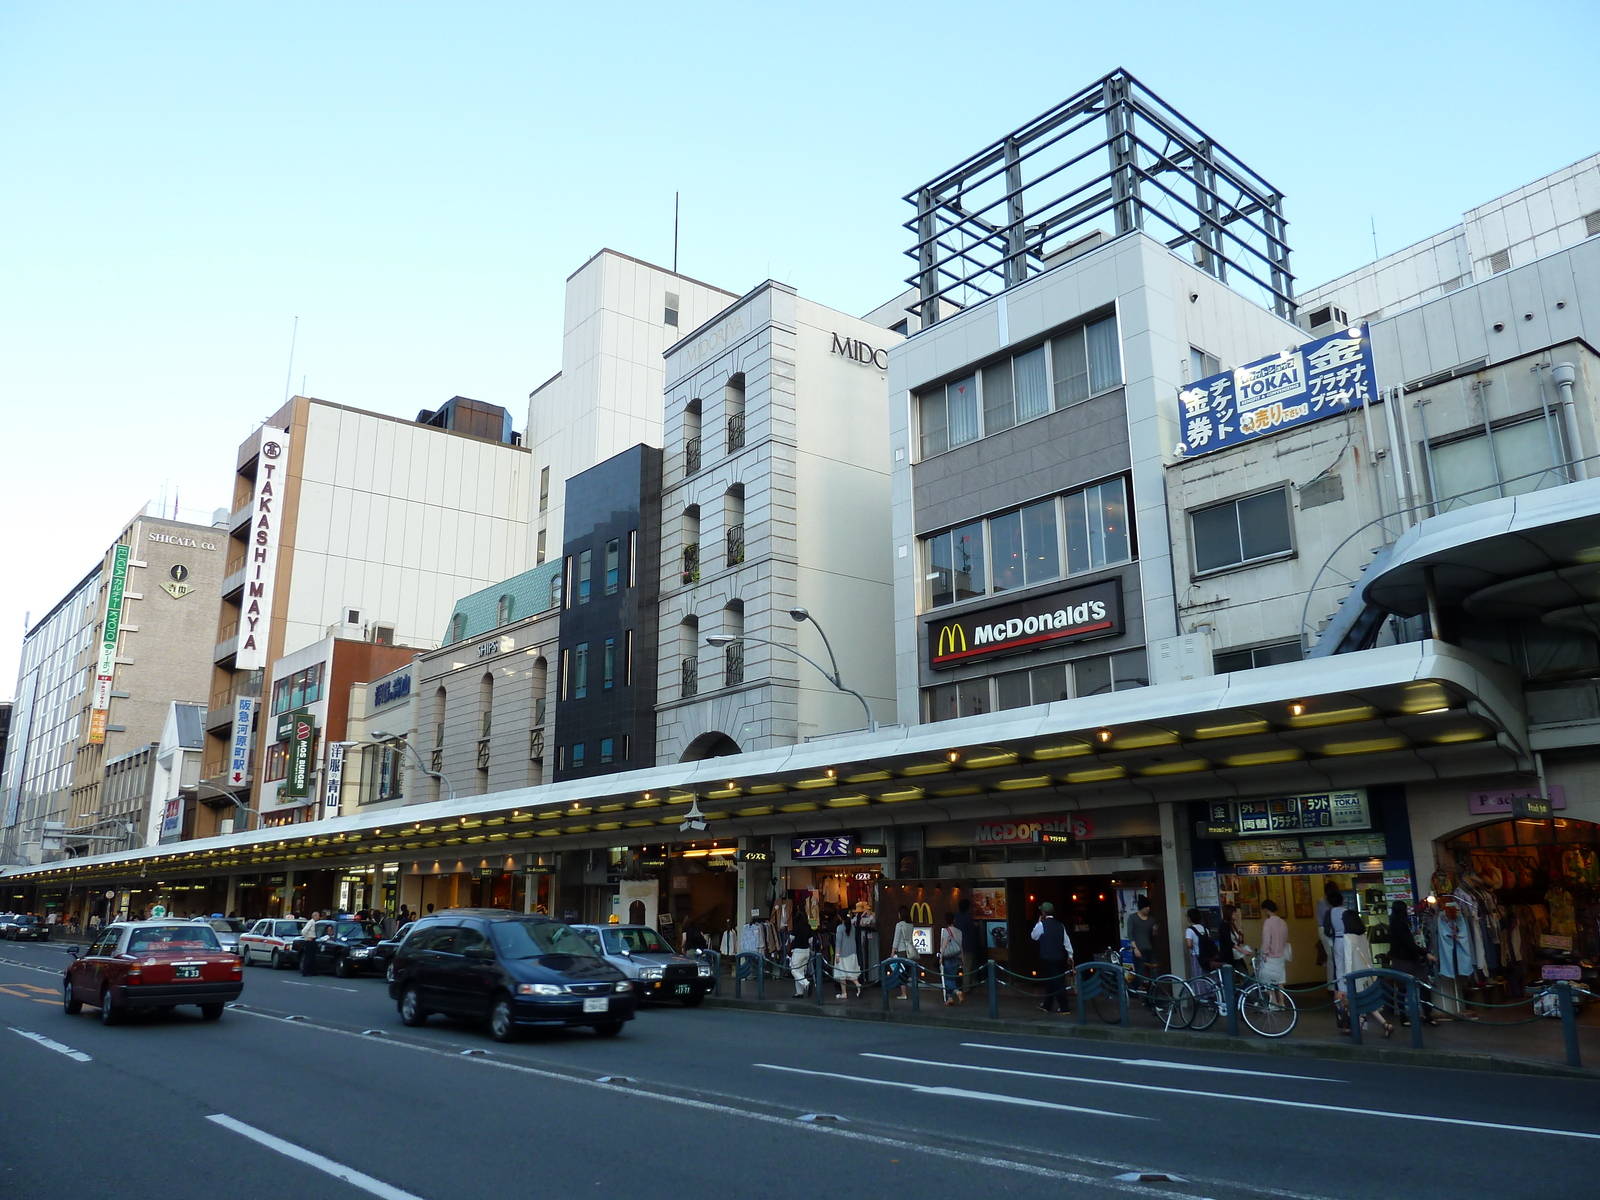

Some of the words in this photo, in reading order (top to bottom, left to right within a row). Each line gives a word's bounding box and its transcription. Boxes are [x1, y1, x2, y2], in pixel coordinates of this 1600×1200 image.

[685, 315, 745, 367] MIDORIYA
[1307, 338, 1364, 375] 金
[1239, 368, 1299, 399] TOKAI
[1308, 363, 1367, 396] プラチナ
[1209, 377, 1234, 440] チケット
[1310, 379, 1368, 412] ブランド
[1185, 387, 1213, 449] 金券
[148, 533, 197, 548] SHICATA
[201, 540, 217, 551] CO.
[244, 464, 275, 650] TAKASHIMAYA
[115, 546, 128, 576] JEUGIA
[112, 579, 123, 608] カルチャー
[106, 611, 118, 640] KYOTO
[974, 600, 1107, 646] McDonald's
[477, 640, 499, 658] SHIPS
[232, 699, 252, 770] 阪急河原町駅
[300, 740, 308, 758] MOS
[296, 759, 306, 789] BURGER
[327, 743, 342, 807] 洋服の青山
[1334, 798, 1360, 806] TOKAI
[1243, 818, 1268, 830] 両替
[798, 837, 850, 856] イシズミ
[914, 938, 926, 948] 24
